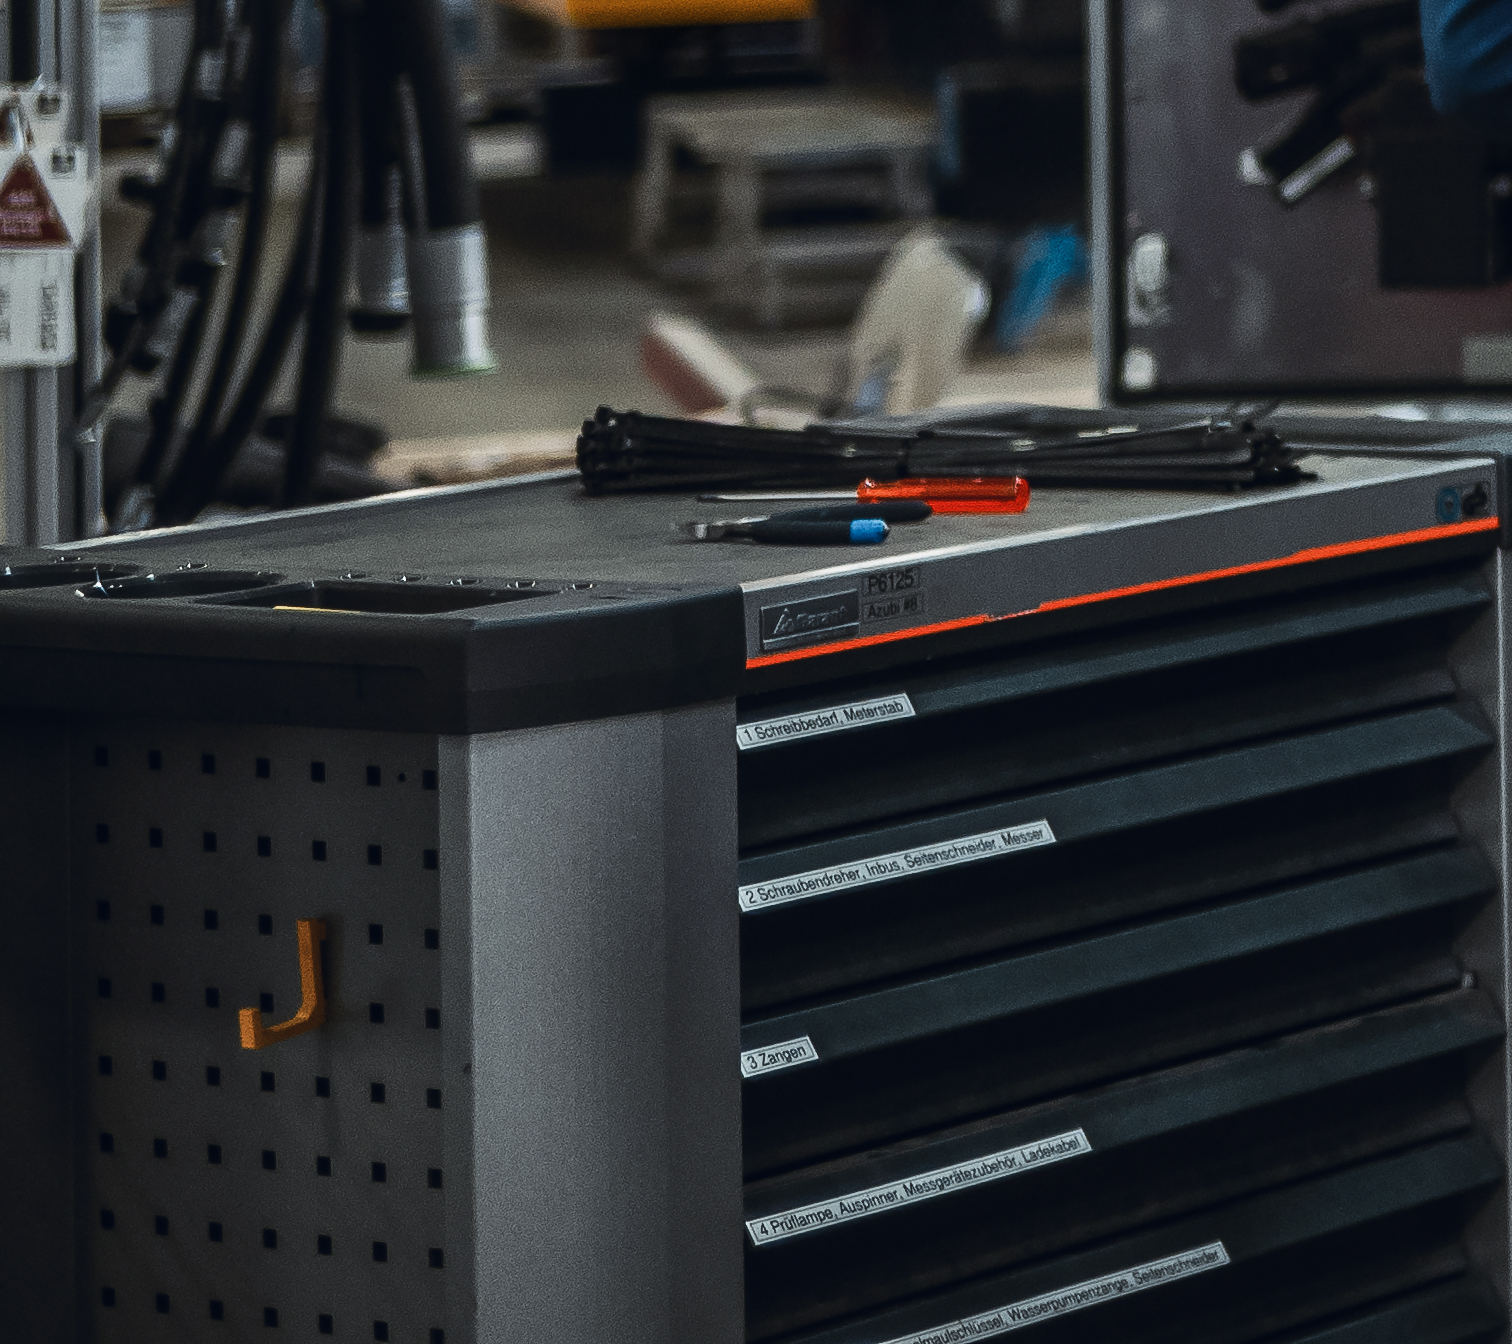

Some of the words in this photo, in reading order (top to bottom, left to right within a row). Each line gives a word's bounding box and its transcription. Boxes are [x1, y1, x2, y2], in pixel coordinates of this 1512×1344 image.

[867, 569, 915, 595] P6125
[755, 712, 844, 740] Schreibbedarf,
[844, 699, 905, 725] Meterstab
[745, 889, 757, 905] 2
[757, 865, 867, 903] Schraubendreher,
[866, 855, 905, 879] Inbus,
[904, 837, 1000, 869] Seitenschneider,
[1002, 827, 1045, 848] Messer
[746, 1054, 757, 1070] 3
[760, 1043, 807, 1070] Zangen
[759, 1221, 770, 1238] 4
[770, 1204, 839, 1237] Prüflampe,
[838, 1186, 903, 1217] Auspinner,
[902, 1152, 1022, 1201] Messgerätezubehör,
[1021, 1136, 1080, 1164] Ladekabel
[1007, 1275, 1134, 1328] Wasserpumpenzange,
